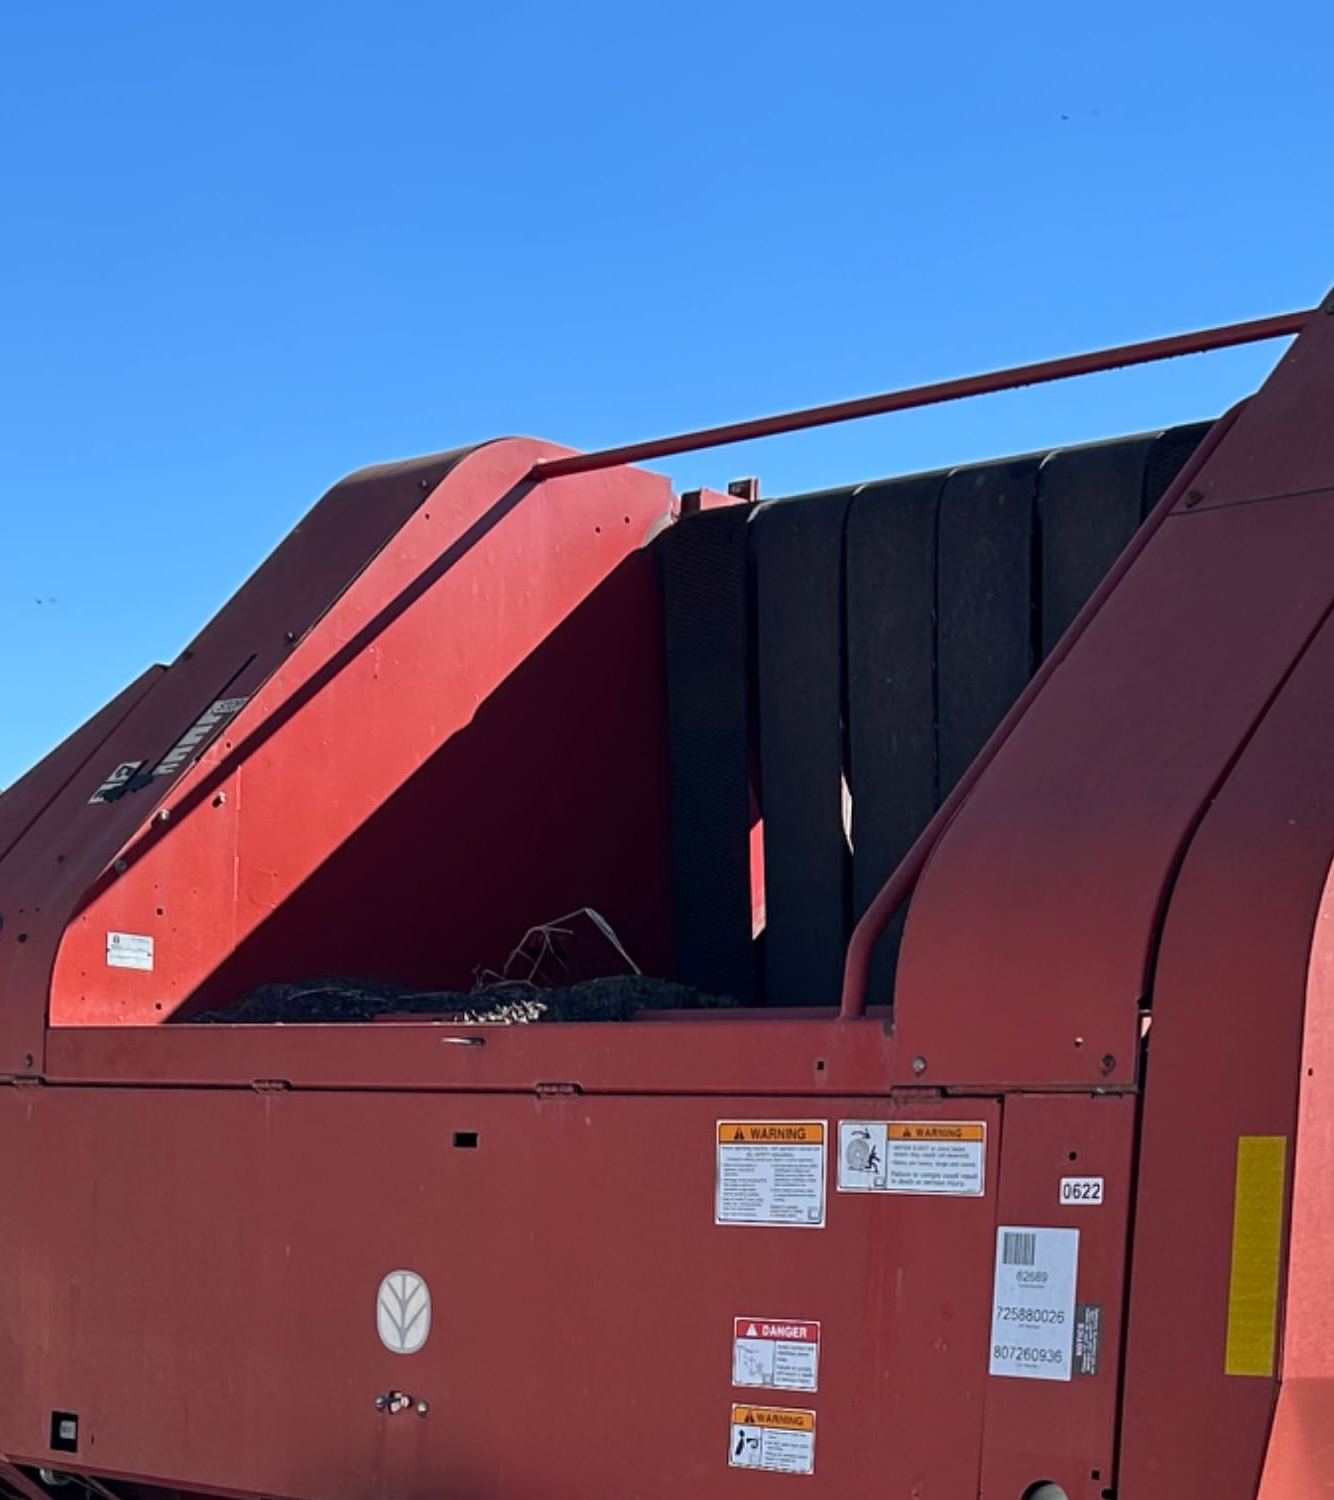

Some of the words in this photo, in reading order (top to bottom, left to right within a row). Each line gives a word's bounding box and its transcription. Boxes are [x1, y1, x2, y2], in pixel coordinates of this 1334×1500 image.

[750, 1127, 807, 1140] WARNING
[916, 1127, 963, 1138] WARNING
[1063, 1183, 1100, 1199] 0622
[996, 1305, 1065, 1325] 725880026
[762, 1325, 808, 1339] DANGER
[993, 1344, 1063, 1364] 807260936
[756, 1413, 805, 1426] WARNING
